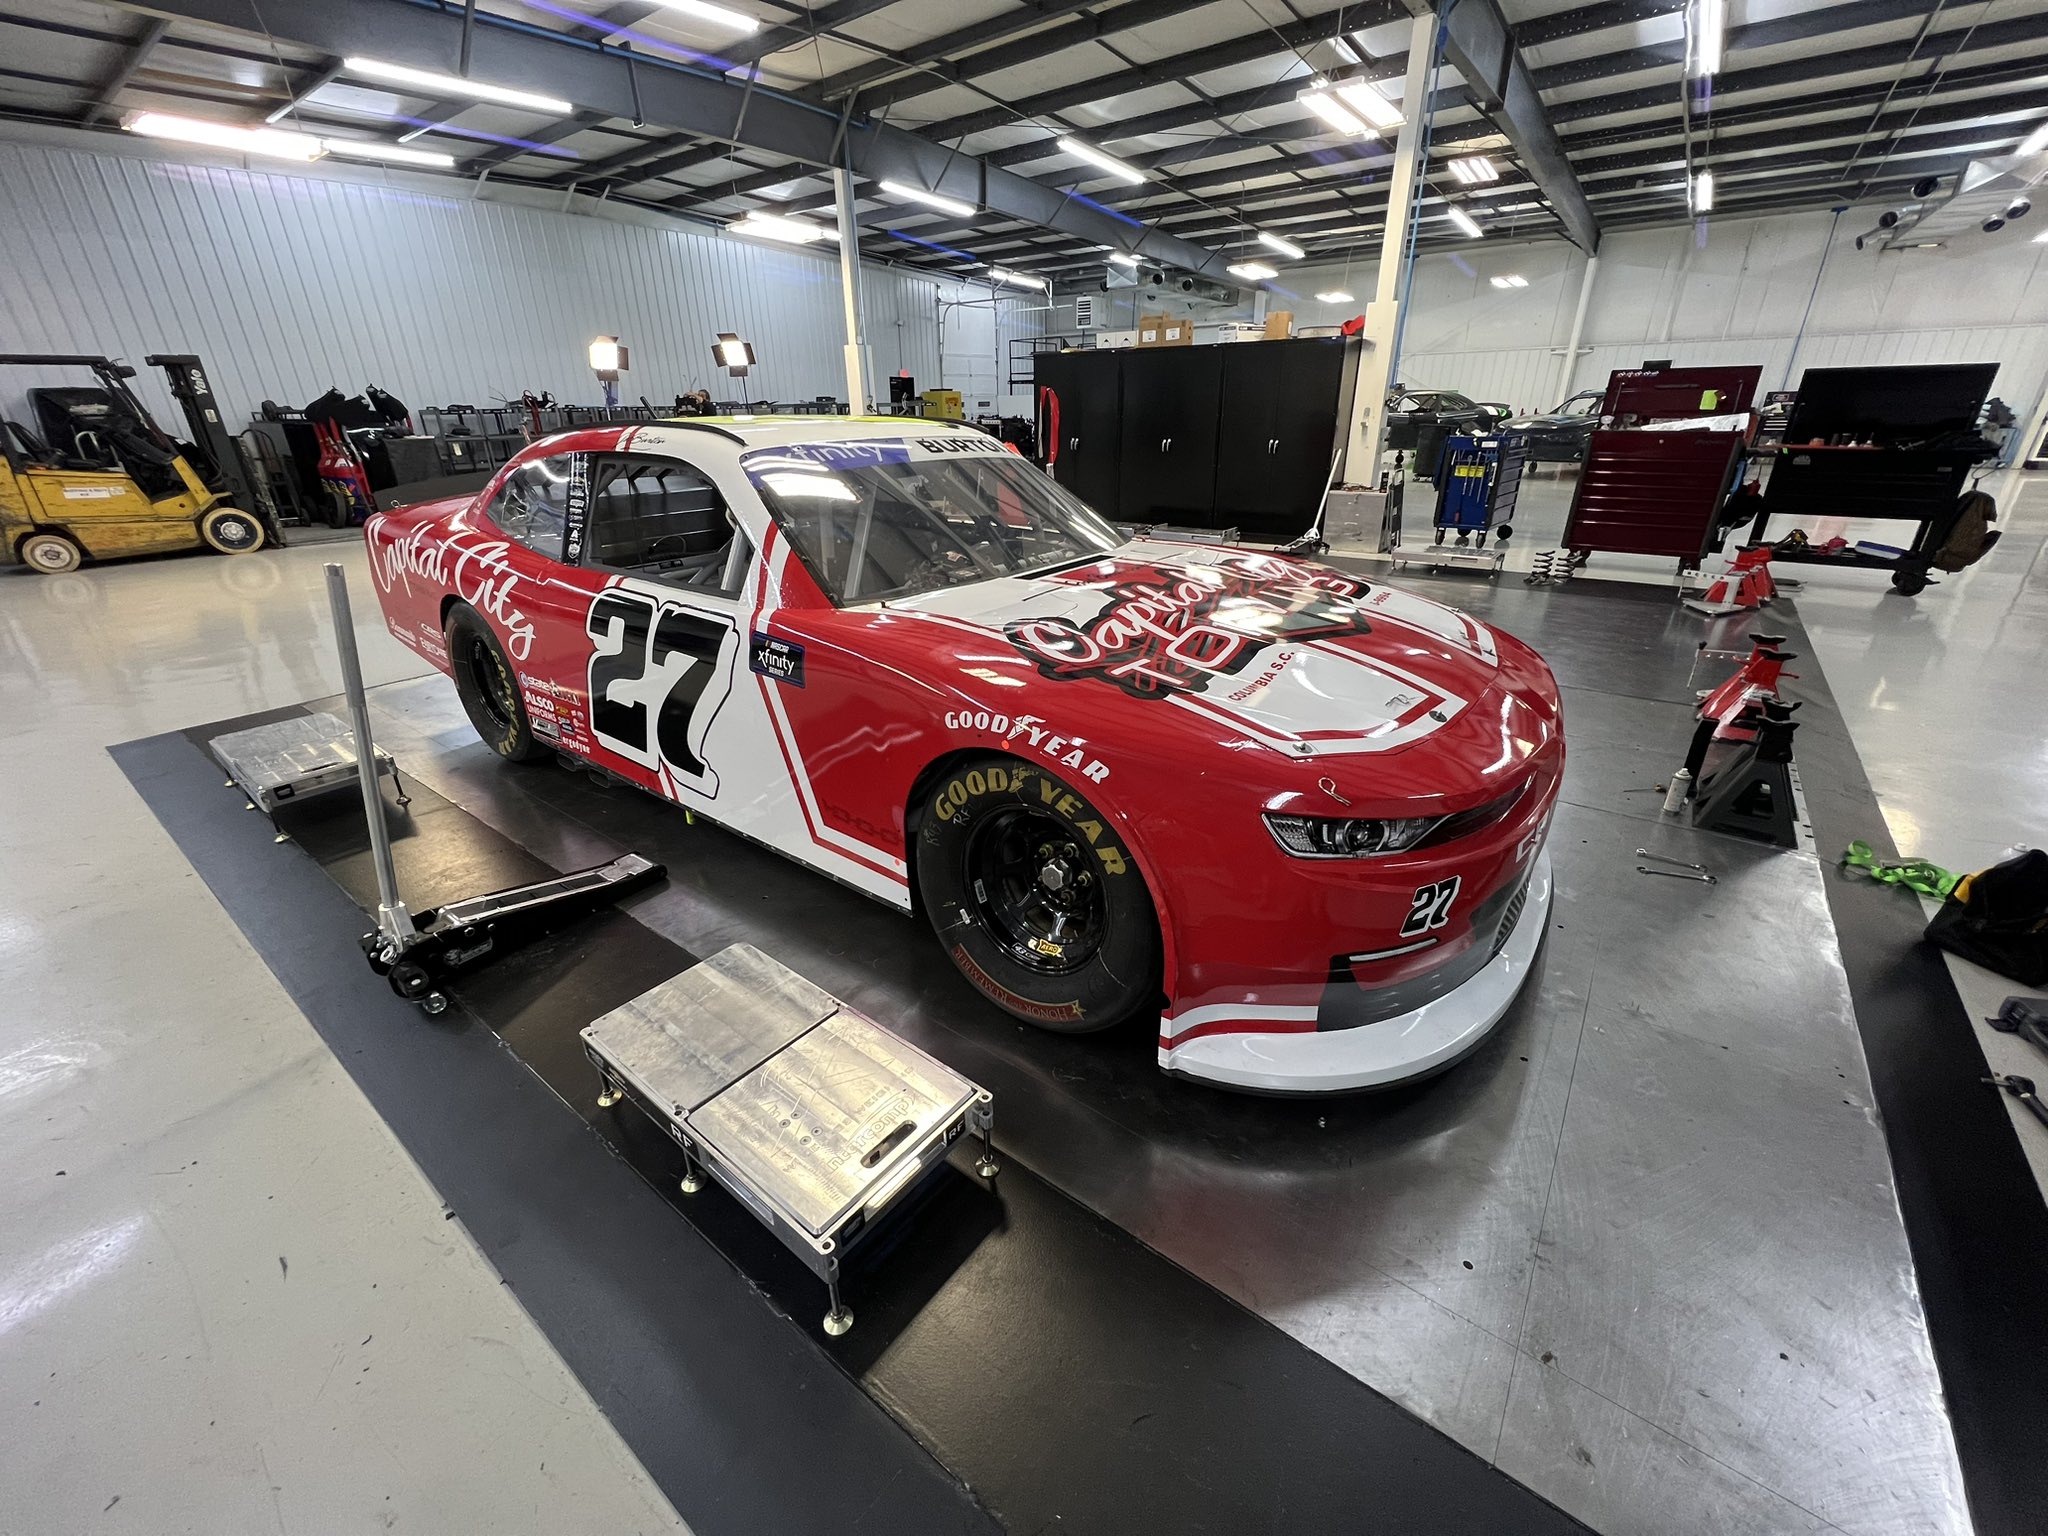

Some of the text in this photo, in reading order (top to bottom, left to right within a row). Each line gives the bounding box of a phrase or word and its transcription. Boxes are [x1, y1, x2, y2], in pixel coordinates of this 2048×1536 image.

[367, 514, 536, 661] Capital City
[770, 641, 790, 653] NASCAR
[757, 648, 795, 676] xfinity
[768, 666, 784, 677] SERIES
[1270, 652, 1295, 671] S.C.
[524, 690, 555, 712] ALSCO
[587, 590, 734, 790] 27
[1399, 875, 1462, 938] 27
[1025, 1004, 1069, 1020] HONOR
[670, 1122, 694, 1148] RF
[948, 1118, 965, 1140] RF
